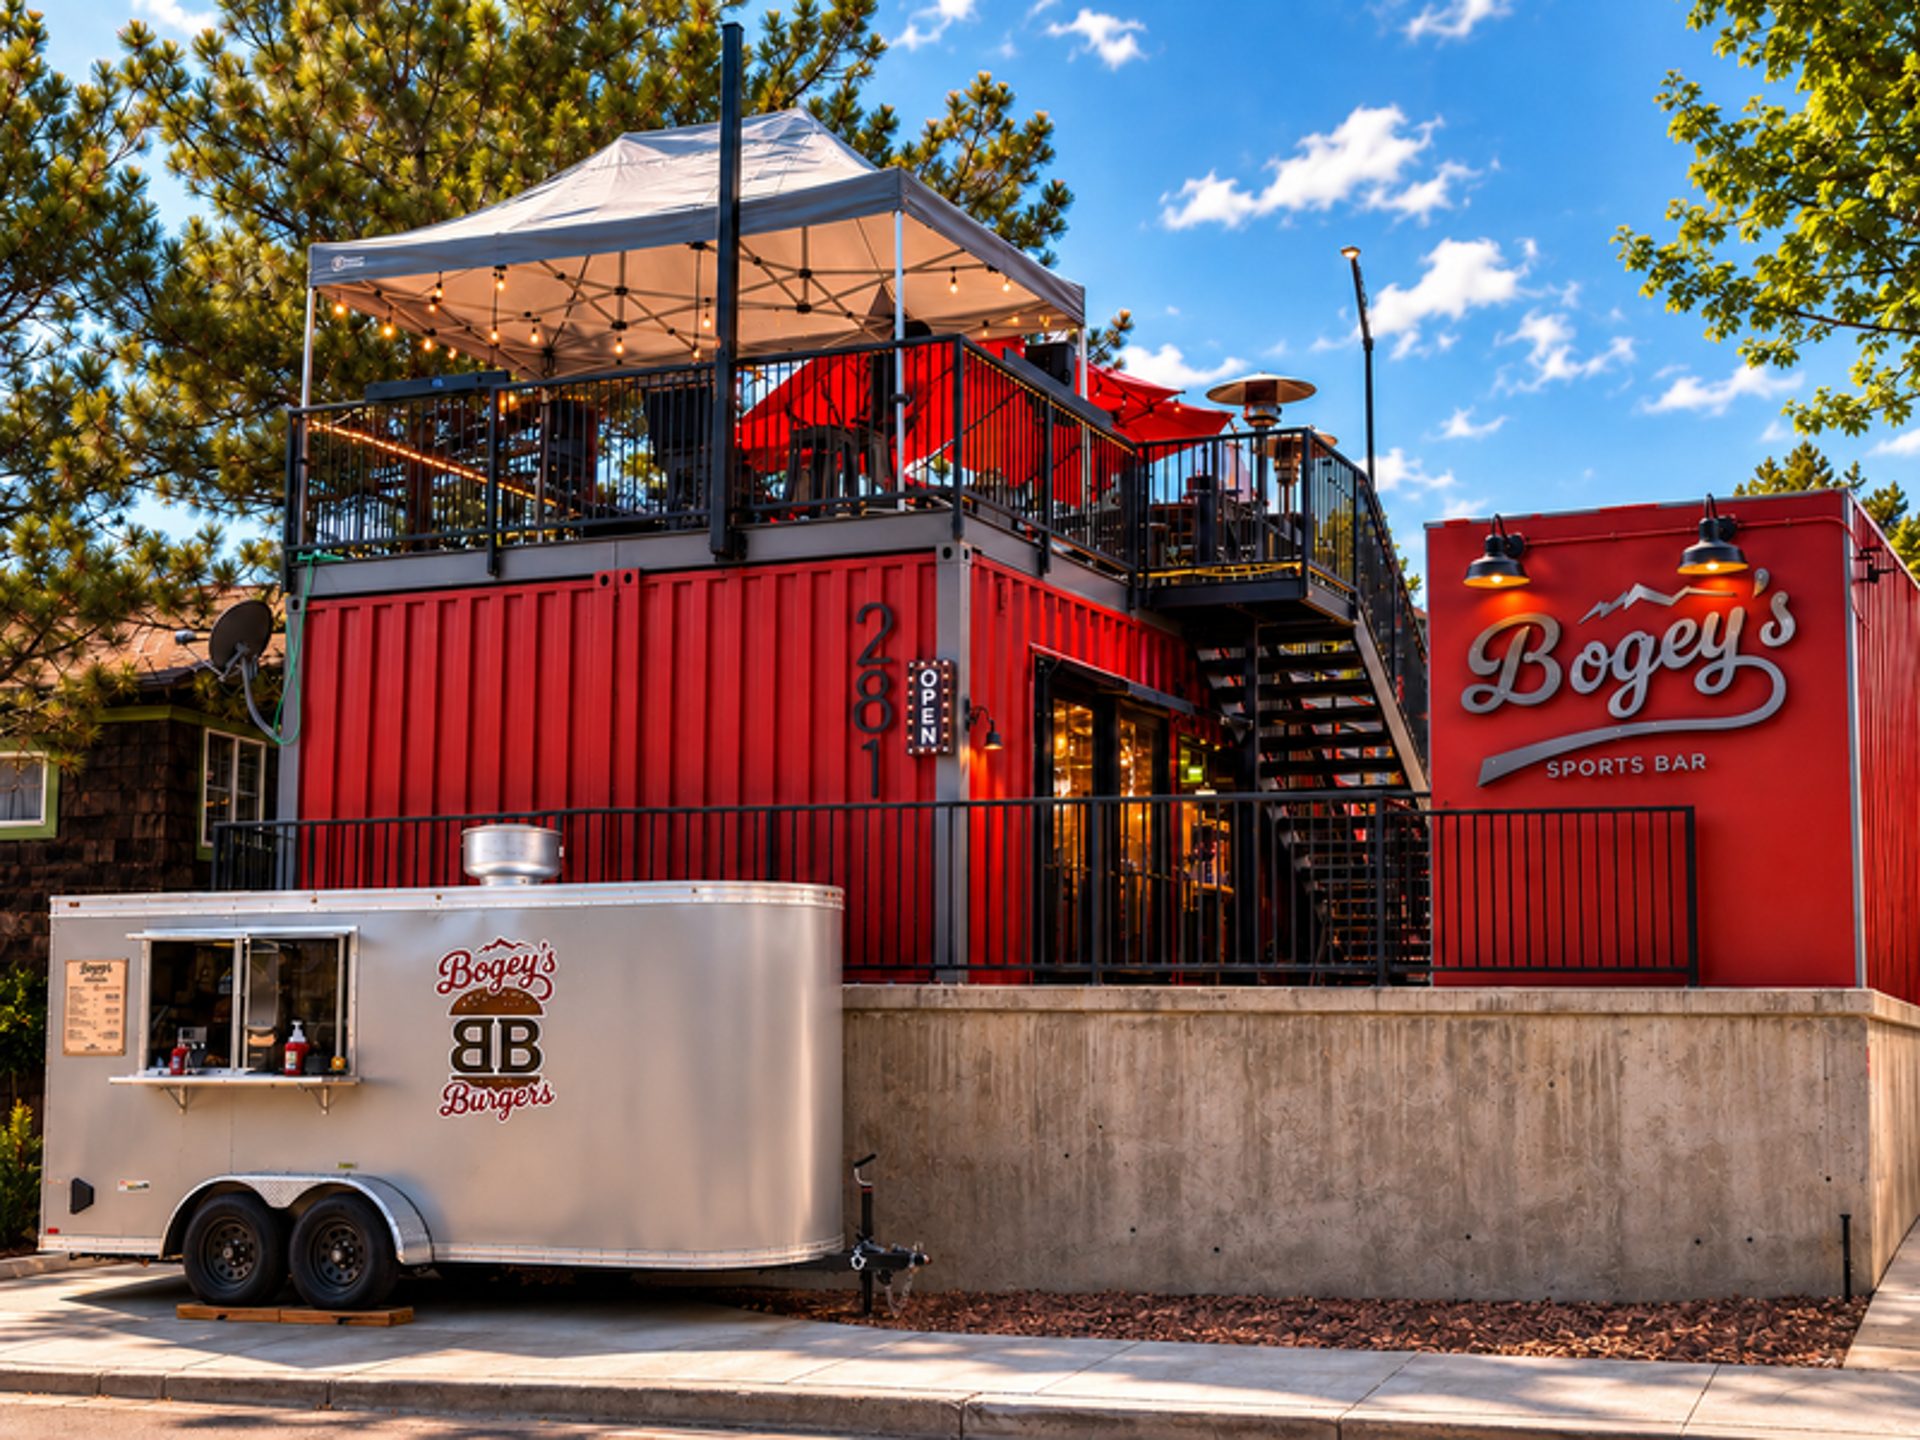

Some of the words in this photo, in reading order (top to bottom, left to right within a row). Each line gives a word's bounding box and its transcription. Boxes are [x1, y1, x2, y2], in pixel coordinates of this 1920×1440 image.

[1461, 568, 1797, 728] Bogey's
[854, 602, 894, 800] 281
[920, 669, 938, 745] OPEN
[1546, 756, 1645, 778] SPORTS
[1655, 753, 1707, 772] BAR
[437, 942, 556, 1001] Bogey's
[439, 1082, 554, 1121] Burgers
